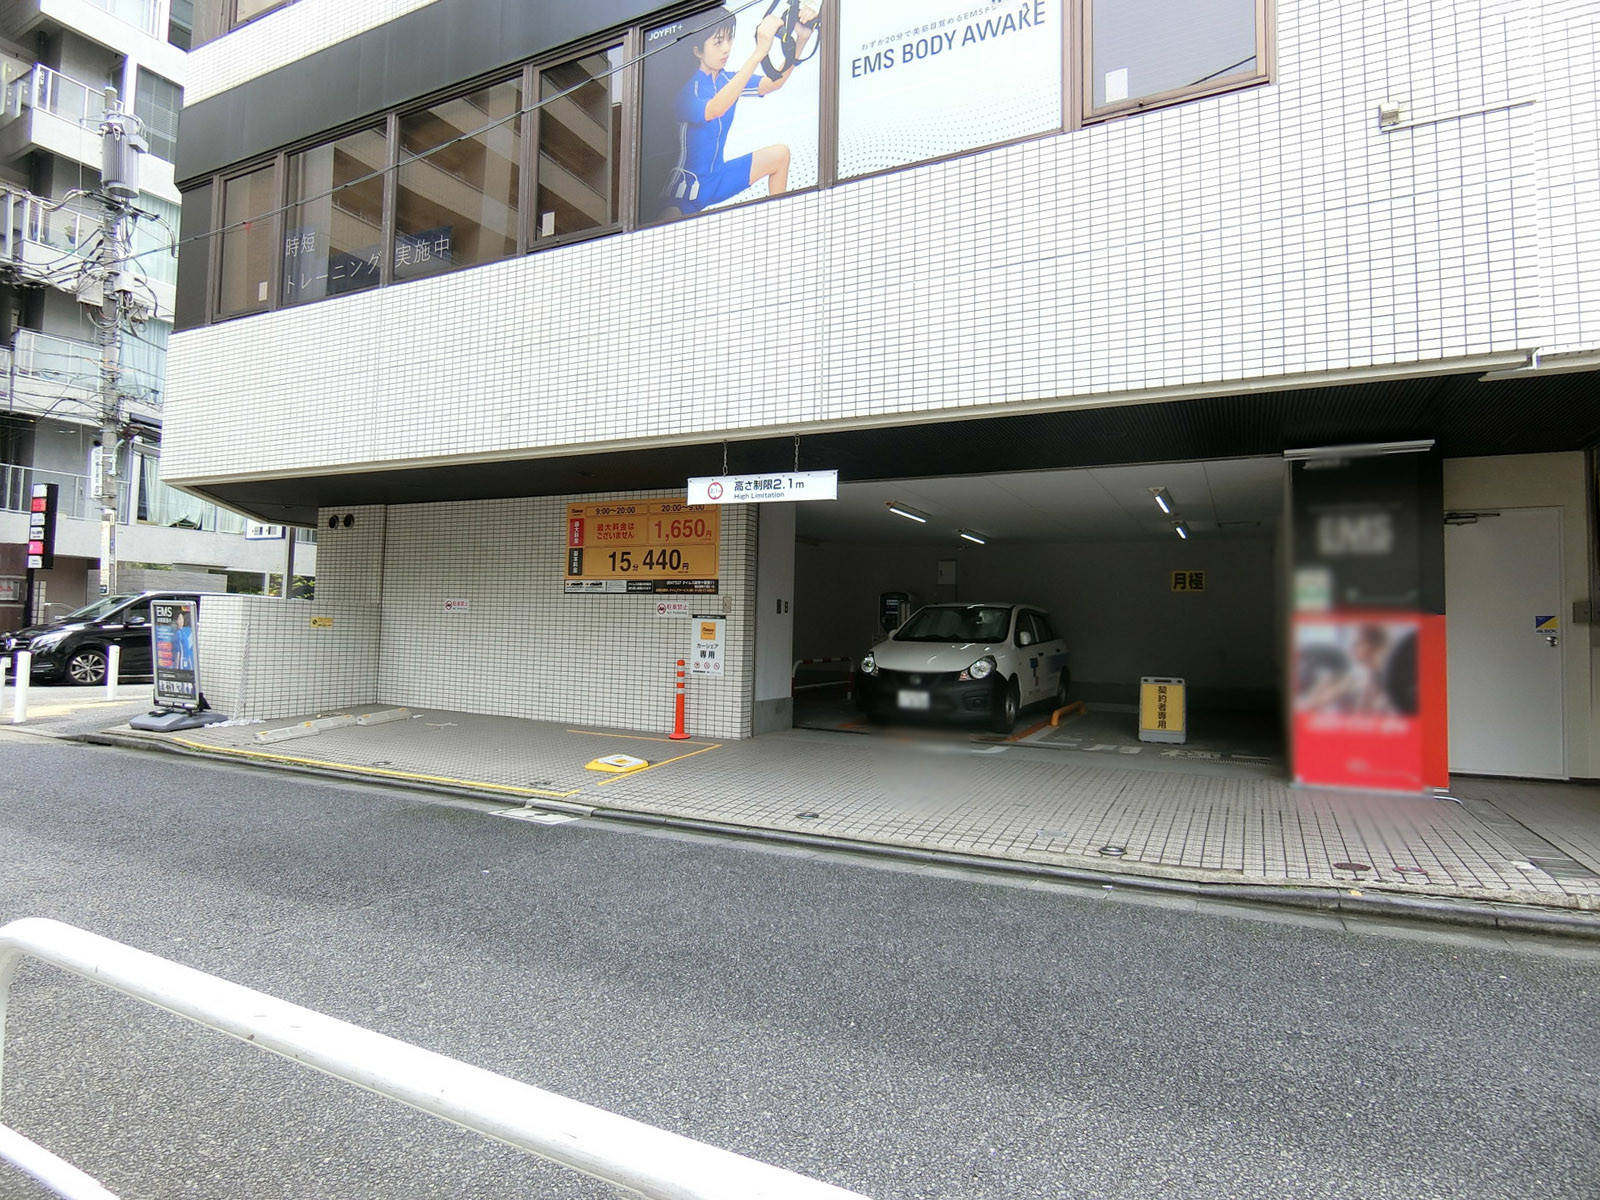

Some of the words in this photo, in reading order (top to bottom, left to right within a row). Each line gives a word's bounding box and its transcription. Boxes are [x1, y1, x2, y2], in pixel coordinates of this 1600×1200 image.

[852, 48, 895, 78] EMS
[902, 29, 957, 63] BODY
[962, 0, 1046, 46] AWAKE
[285, 231, 316, 257] 時短
[751, 491, 785, 499] Limitation
[597, 522, 635, 531] 最大料金は
[596, 530, 635, 540] ございません
[1173, 572, 1204, 590] 月極
[156, 606, 173, 617] EMS
[700, 650, 716, 659] 専用
[1157, 685, 1168, 729] 契約者専用
